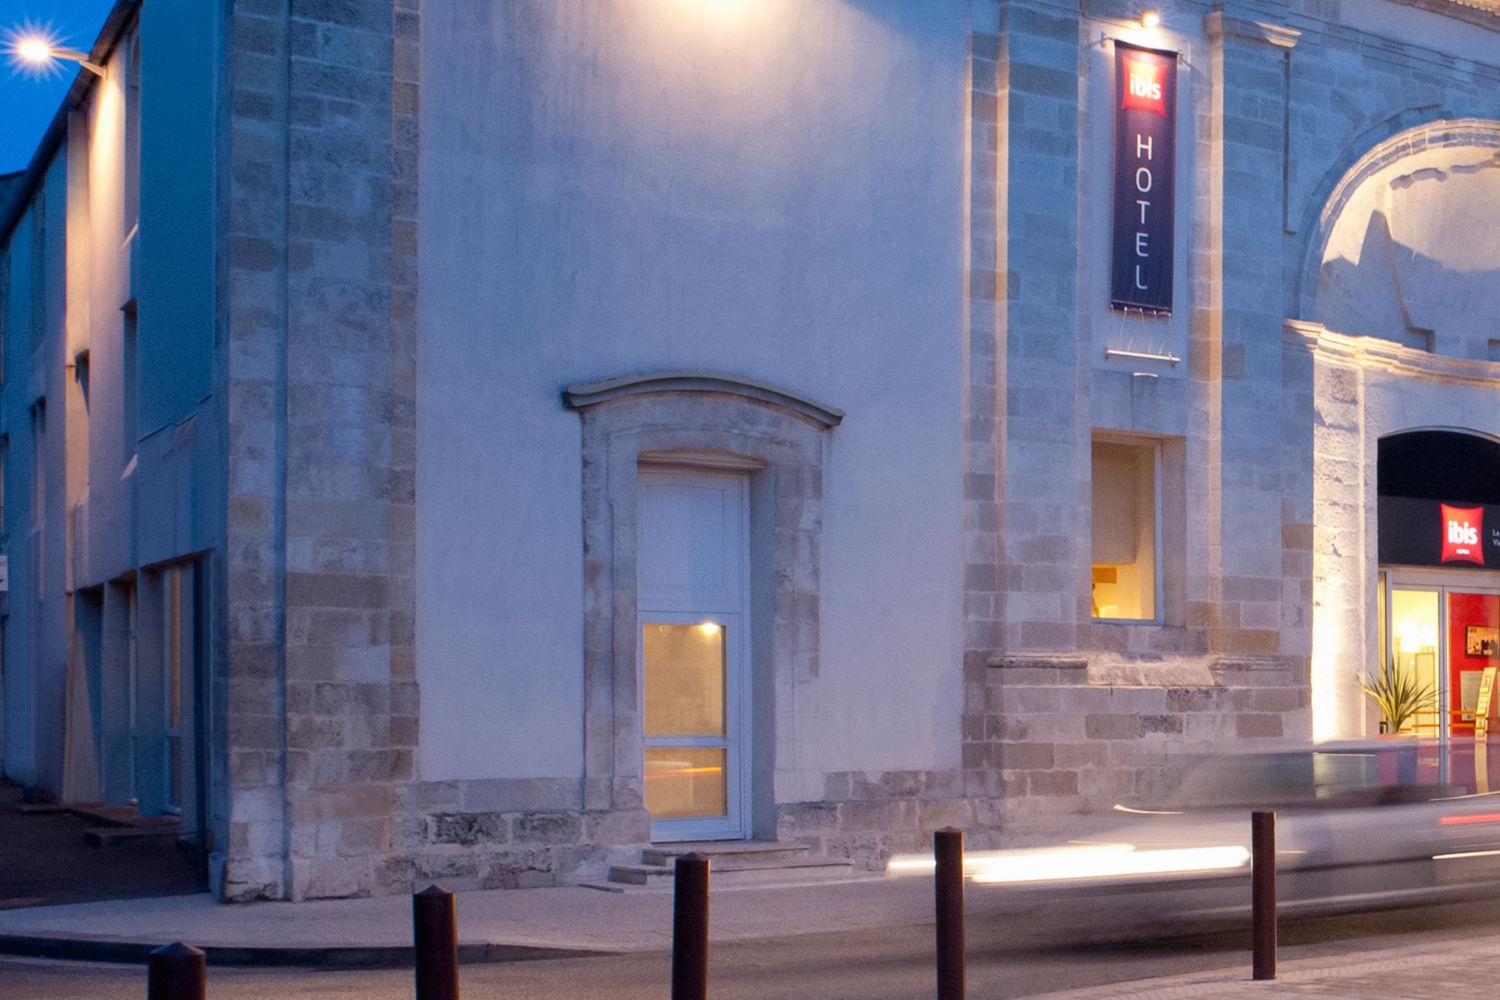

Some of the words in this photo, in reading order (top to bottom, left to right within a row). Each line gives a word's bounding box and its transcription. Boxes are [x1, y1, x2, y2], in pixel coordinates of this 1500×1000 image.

[1129, 72, 1161, 100] ibis
[1135, 133, 1153, 290] HOTEL
[1447, 520, 1478, 545] ibis
